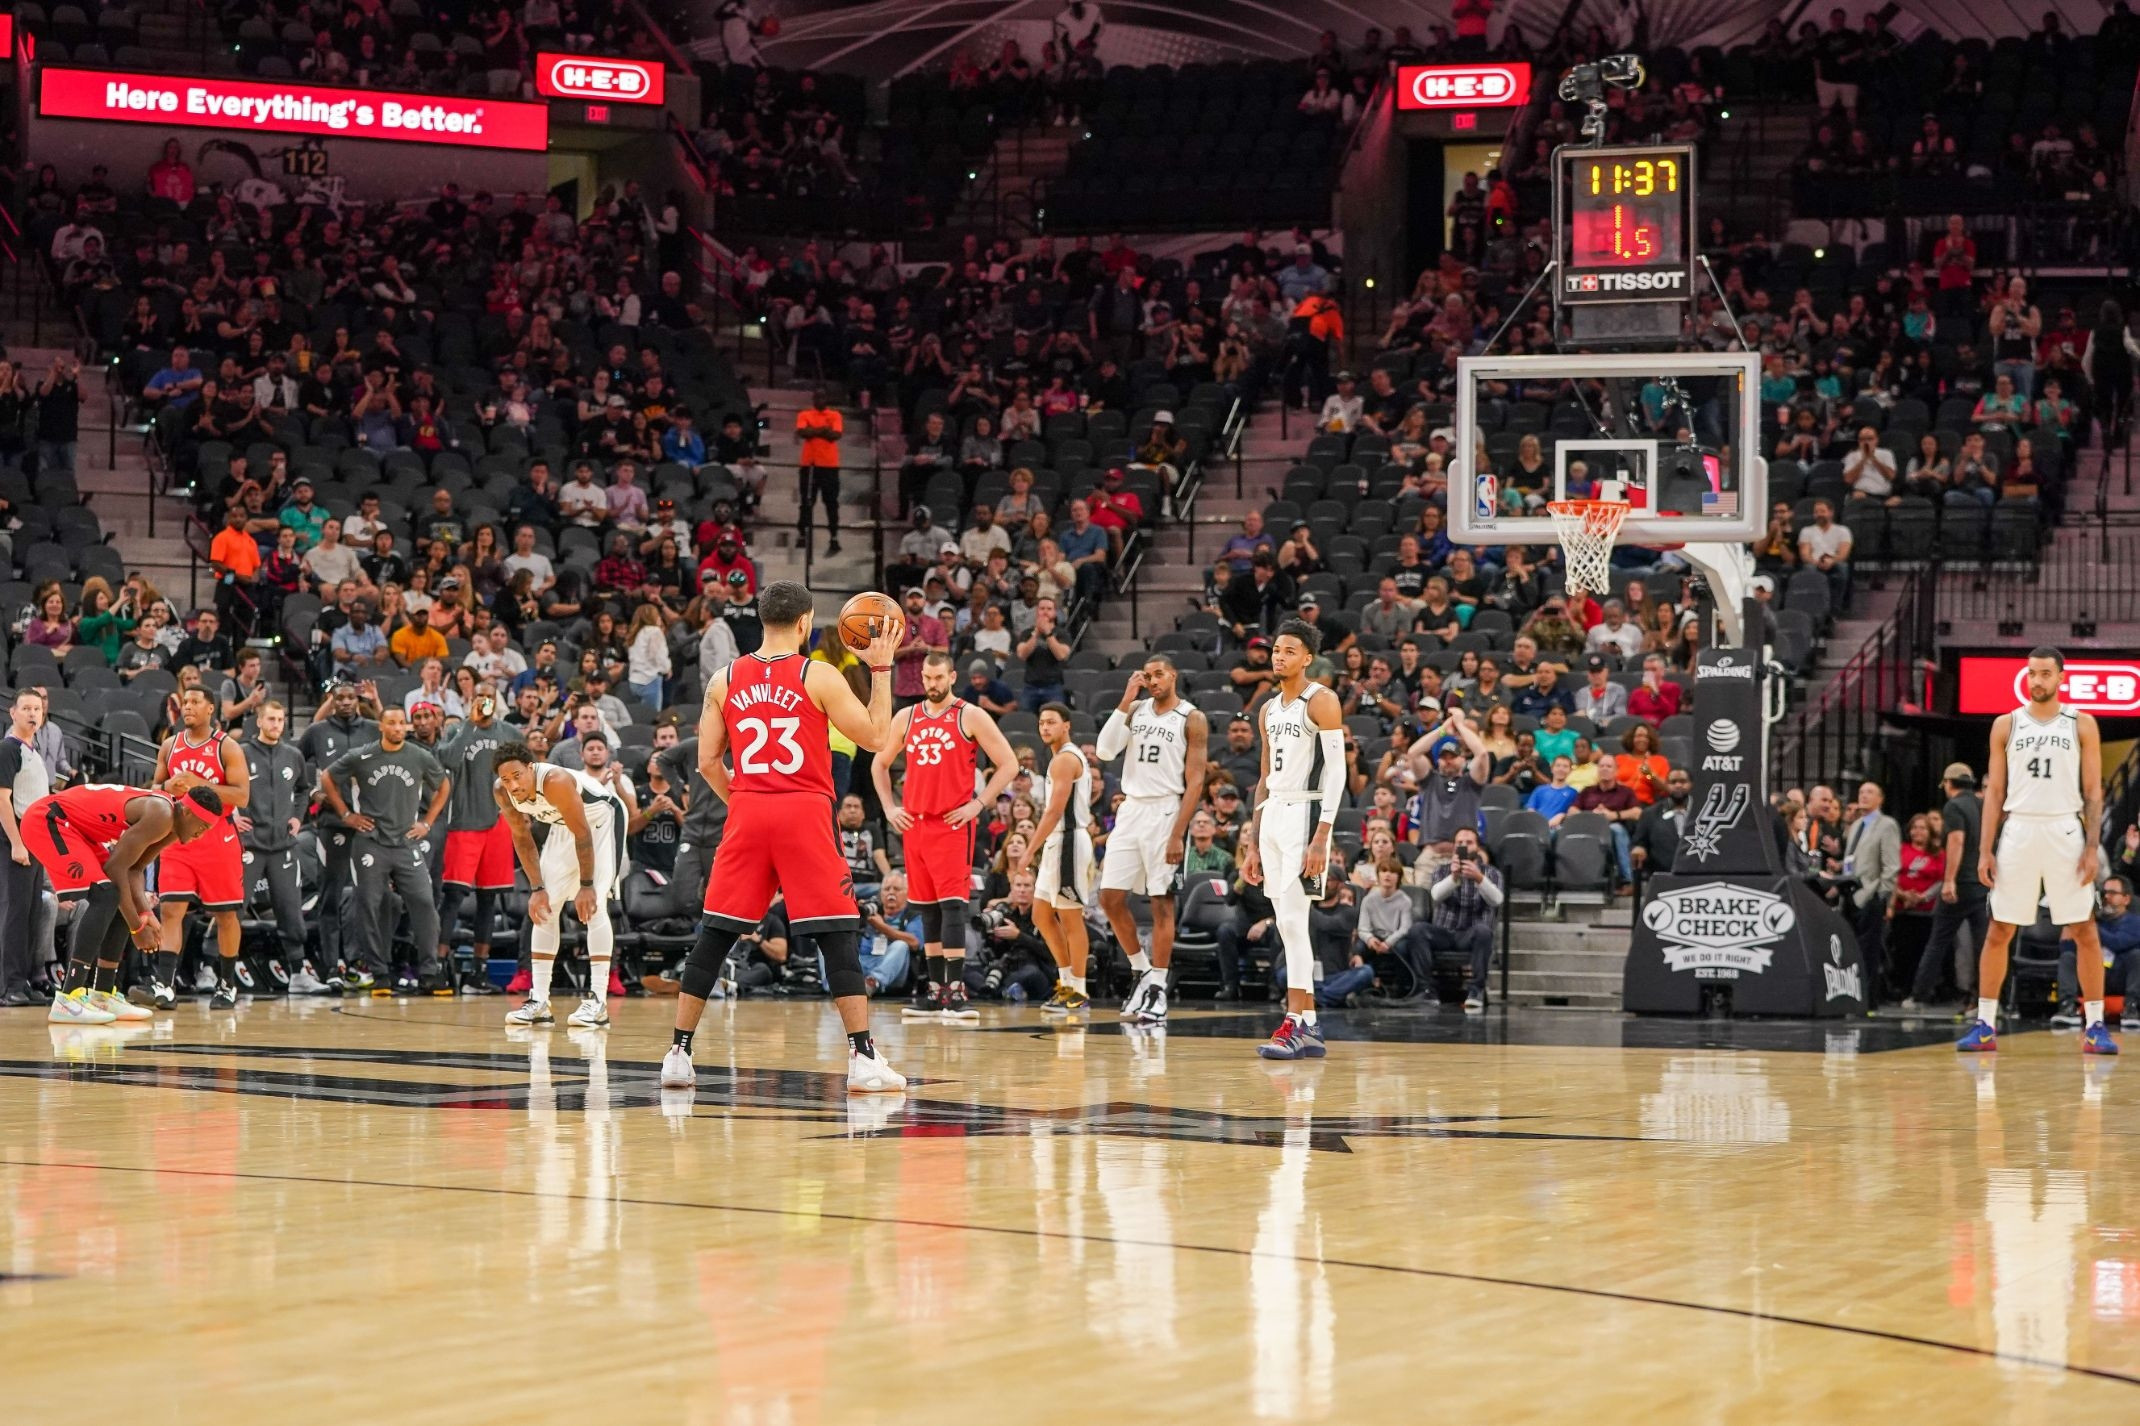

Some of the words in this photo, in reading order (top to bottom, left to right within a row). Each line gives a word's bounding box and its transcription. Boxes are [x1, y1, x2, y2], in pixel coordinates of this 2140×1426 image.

[106, 82, 178, 111] Here
[187, 87, 374, 129] Everything's
[285, 151, 327, 174] 112
[1592, 160, 1676, 195] 11:37
[1599, 271, 1685, 291] TISSOT
[1697, 665, 1752, 678] SPALDING
[730, 683, 804, 712] VANVLEET
[906, 727, 956, 753] RAPTORS
[1131, 724, 1175, 743] SPURS
[2015, 735, 2071, 752] SPURS
[736, 717, 805, 775] 23
[916, 743, 942, 765] 33
[1138, 744, 1161, 763] 12
[1275, 748, 1283, 772] 5
[1702, 755, 1744, 772] AT&T
[2027, 757, 2052, 778] 41
[367, 764, 415, 787] RAPTORS
[643, 820, 675, 844] 20
[1678, 897, 1761, 916] BRAKE
[1677, 918, 1759, 937] CHECK
[1682, 954, 1697, 963] WE
[1700, 953, 1712, 962] DO
[1714, 953, 1723, 961] IT
[1725, 954, 1752, 965] RIGHT
